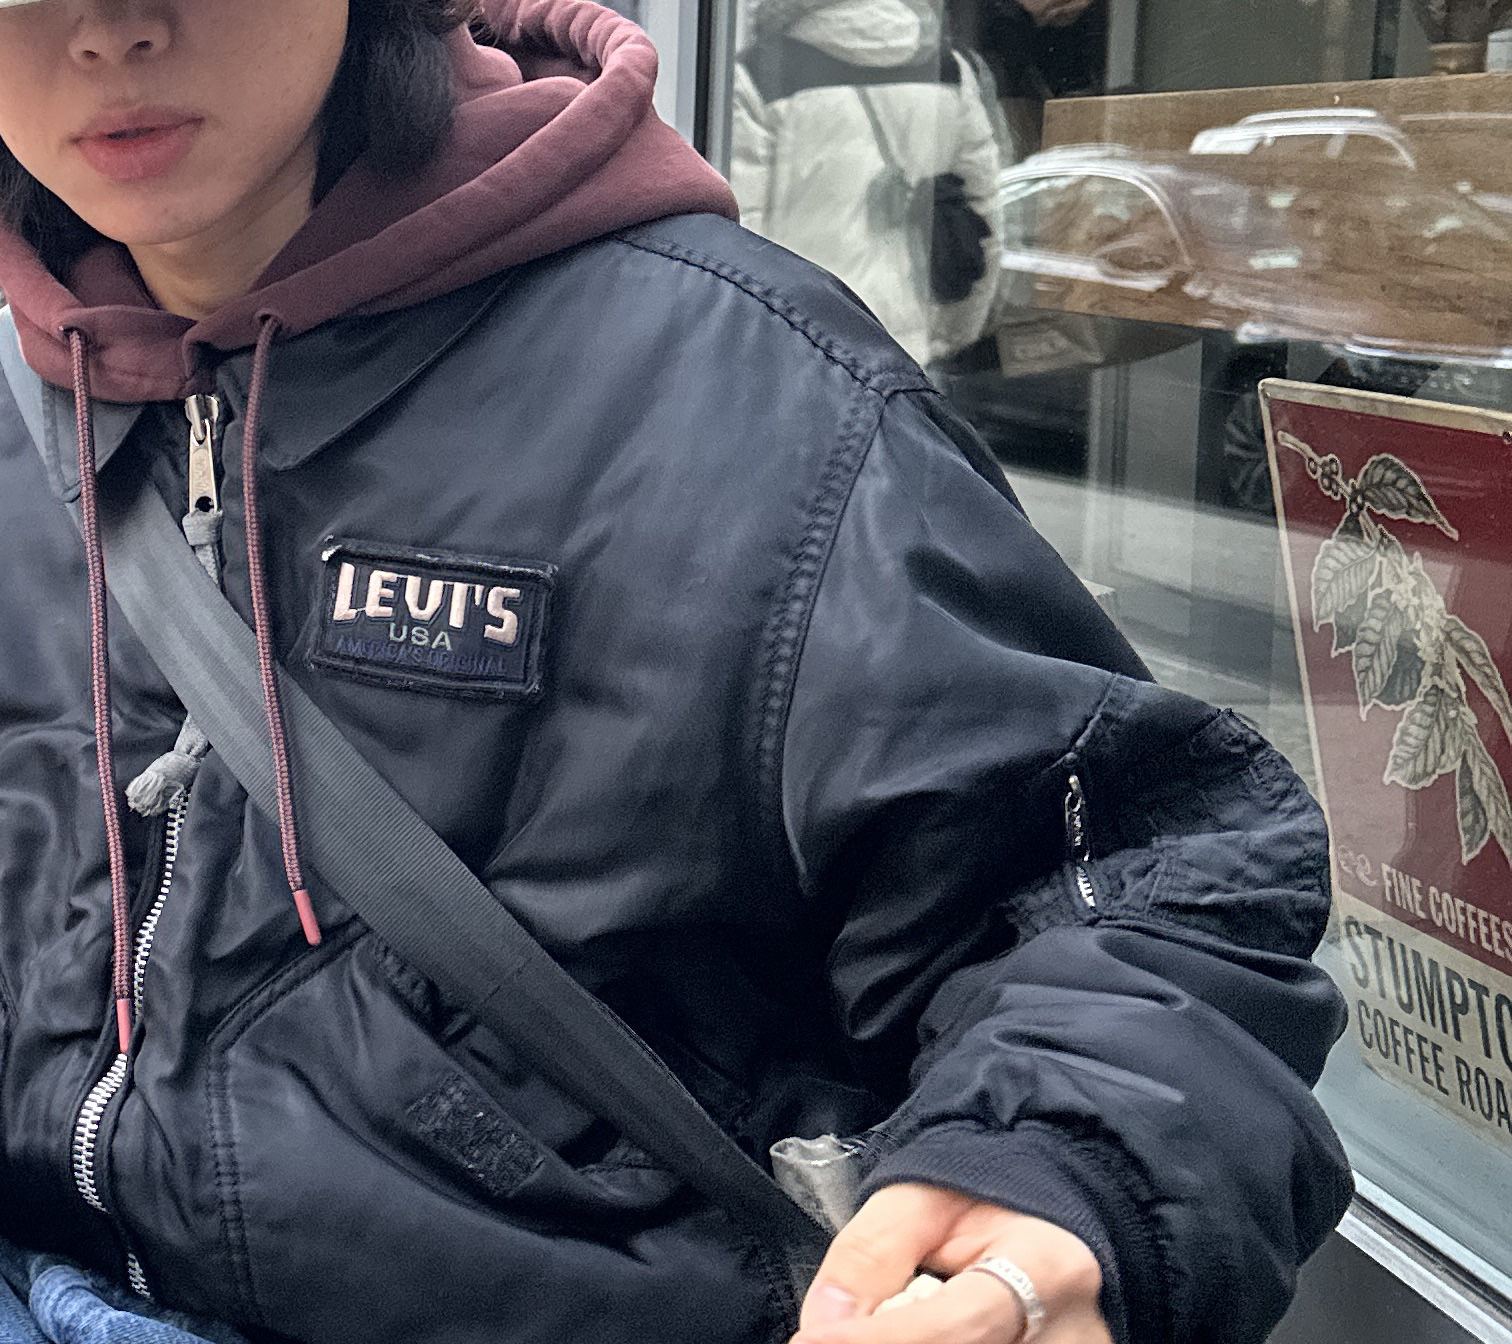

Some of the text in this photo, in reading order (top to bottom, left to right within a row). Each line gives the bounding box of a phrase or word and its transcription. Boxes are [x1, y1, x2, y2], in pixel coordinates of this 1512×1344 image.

[333, 562, 521, 645] LEVI'S
[390, 623, 453, 651] USA
[1381, 862, 1512, 965] FINE COFFEES
[1357, 999, 1449, 1096] COFFEE
